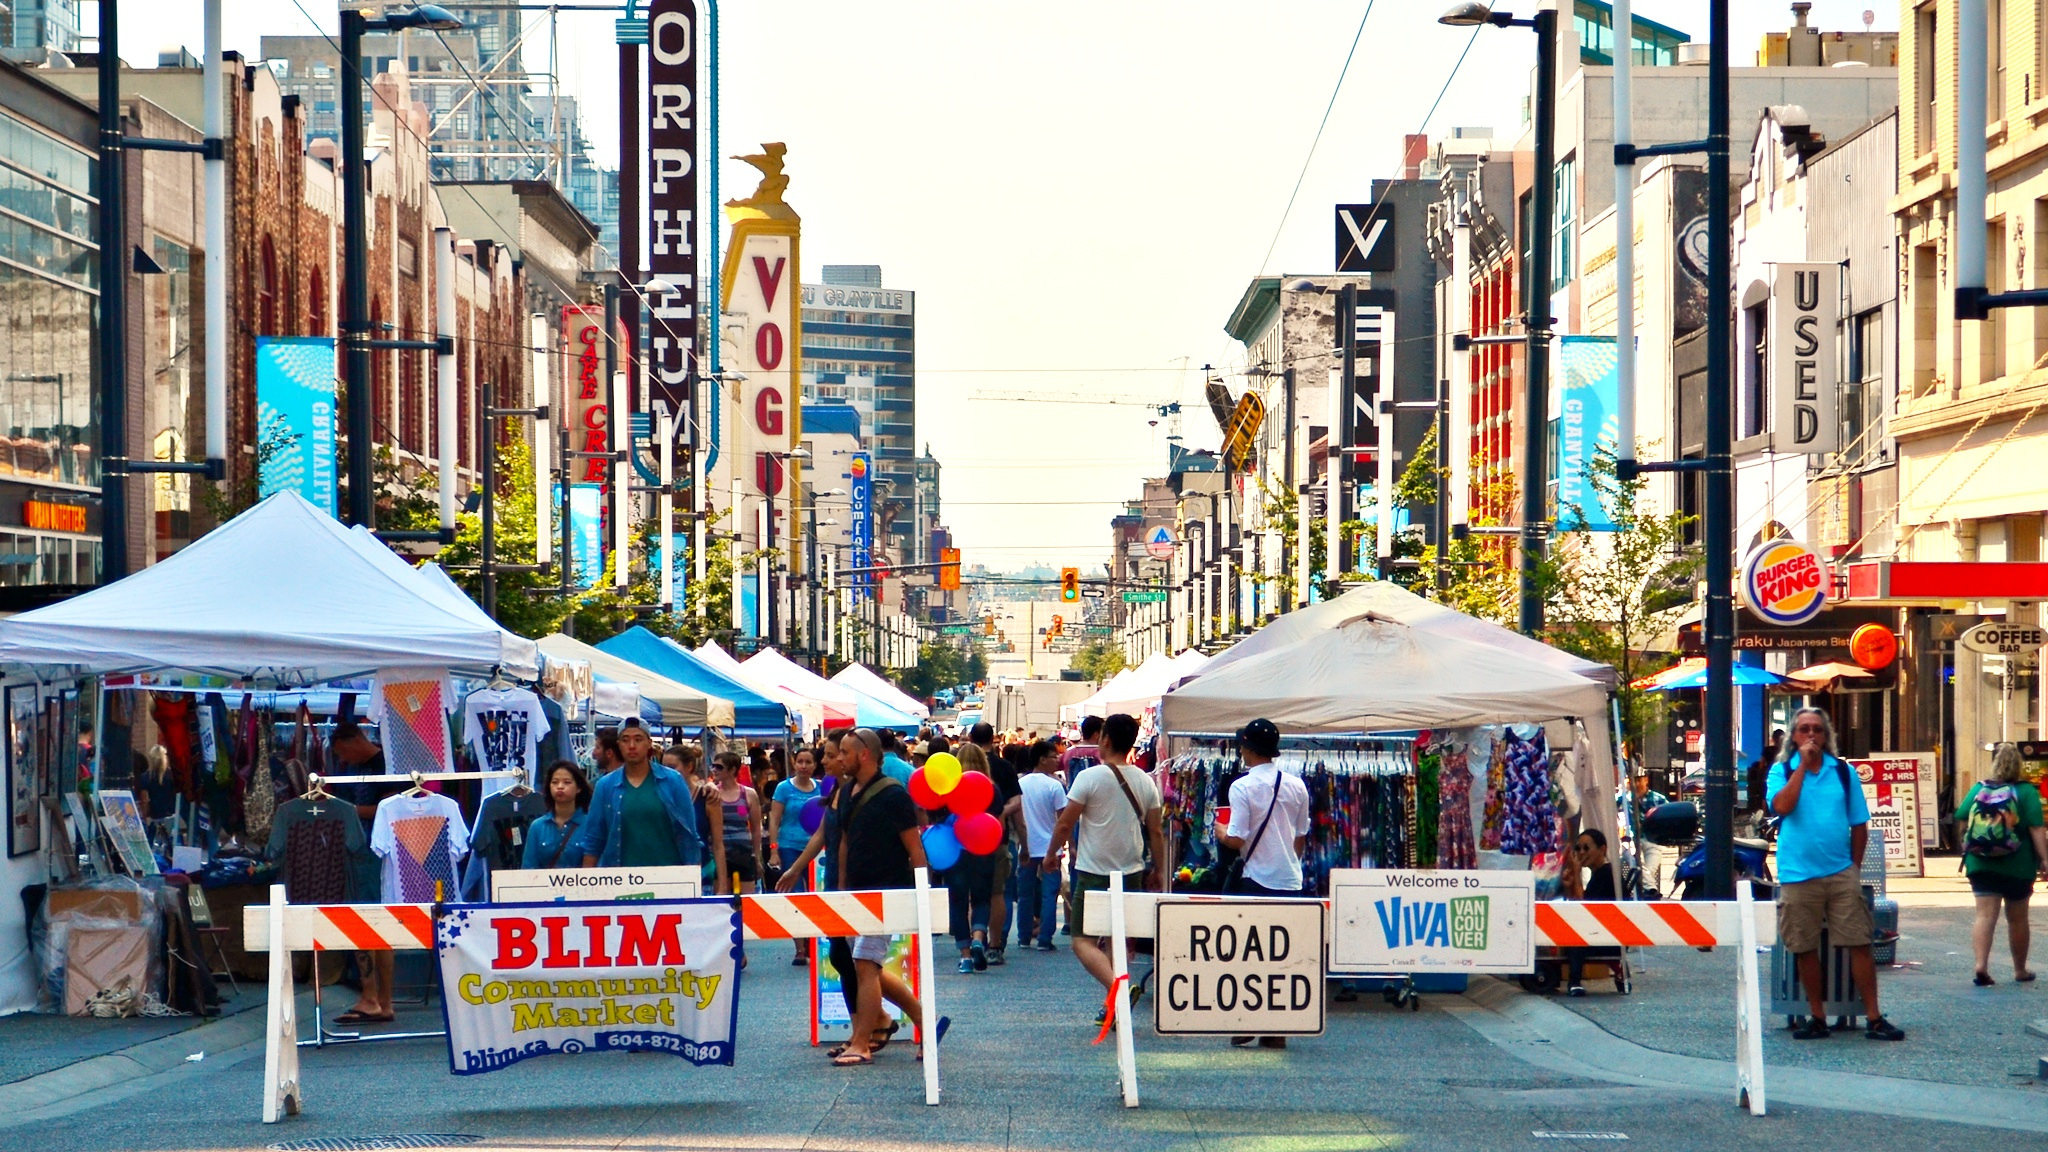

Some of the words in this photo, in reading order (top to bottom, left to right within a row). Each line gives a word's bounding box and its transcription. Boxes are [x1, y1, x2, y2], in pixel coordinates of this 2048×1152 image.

[652, 11, 692, 444] ORPHEUM
[824, 289, 904, 310] GRANVILLE
[1793, 271, 1819, 444] USED
[853, 485, 865, 568] Comfort
[1756, 553, 1816, 589] BURGER
[1760, 567, 1820, 608] KING
[1776, 638, 1828, 648] Japanese
[1830, 636, 1851, 647] Bist
[1975, 630, 2041, 644] COFFEE
[1998, 645, 2020, 653] BAR
[2006, 660, 2014, 700] 827
[1882, 772, 1894, 781] 24
[1896, 772, 1915, 780] HRS
[1883, 762, 1913, 770] OPEN
[1871, 818, 1901, 828] KING
[1884, 828, 1901, 839] ALS
[1885, 847, 1900, 855] .39
[549, 873, 623, 887] Welcome
[628, 873, 644, 885] to
[1386, 874, 1459, 888] Welcome
[1464, 876, 1480, 888] to
[1454, 900, 1485, 915] VAN
[1374, 896, 1450, 950] VIVA
[1454, 916, 1485, 931] COU
[491, 914, 685, 969] BLIM
[1190, 924, 1290, 961] ROAD
[1454, 931, 1485, 947] VER
[458, 967, 722, 1010] Community
[1168, 973, 1312, 1011] CLOSED
[512, 998, 675, 1033] Market
[463, 1040, 549, 1072] blim.ca
